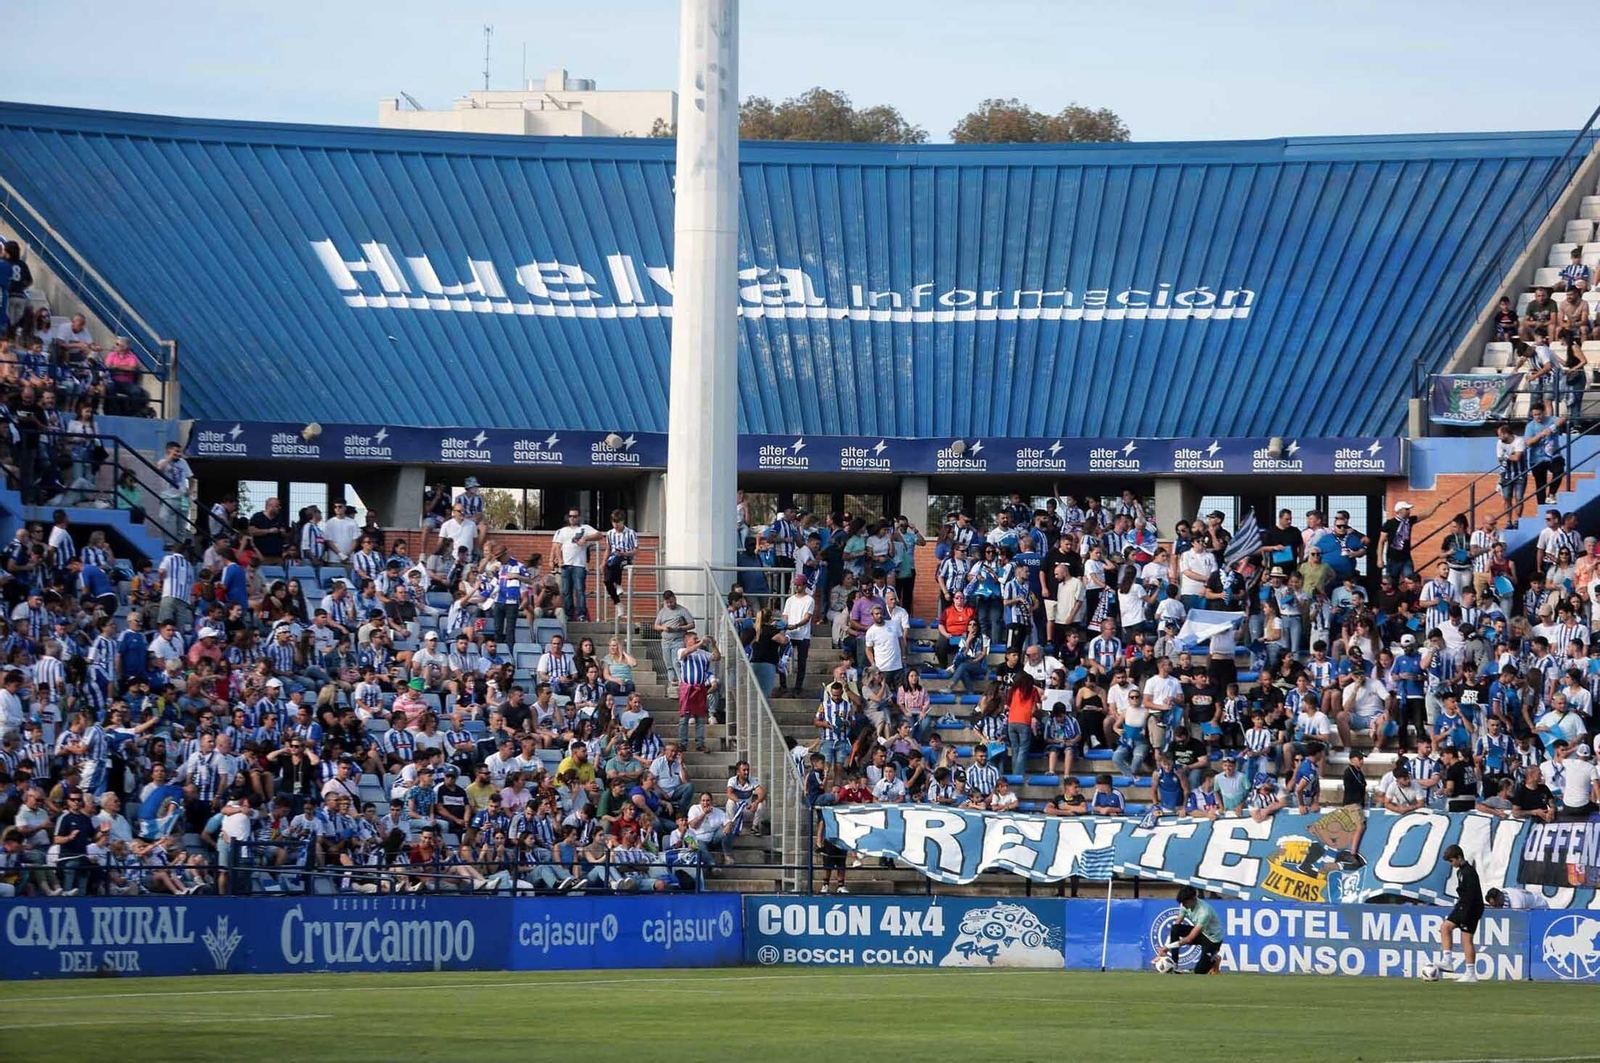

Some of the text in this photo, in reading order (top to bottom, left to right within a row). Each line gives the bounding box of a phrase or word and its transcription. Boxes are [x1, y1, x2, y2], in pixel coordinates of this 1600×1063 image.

[851, 278, 1256, 307] Información
[199, 431, 226, 442] alter
[272, 433, 299, 444] alter
[345, 435, 371, 446] alter
[198, 442, 247, 452] enersun
[271, 444, 320, 454] enersun
[442, 438, 469, 449] alter
[514, 440, 541, 450] alter
[344, 446, 392, 456] enersun
[441, 448, 491, 459] enersun
[513, 450, 563, 461] enersun
[759, 445, 787, 456] alter
[841, 447, 869, 458] alter
[1017, 448, 1045, 458] alter
[1090, 448, 1118, 459] alter
[1174, 449, 1202, 459] alter
[1335, 449, 1363, 460] alter
[591, 452, 640, 462] enersun
[759, 455, 809, 466] enersun
[841, 457, 891, 468] enersun
[937, 458, 987, 468] enersun
[1017, 458, 1066, 468] enersun
[1090, 459, 1140, 469] enersun
[1174, 459, 1224, 469] enersun
[1253, 459, 1303, 469] enersun
[1334, 459, 1385, 469] enersun
[833, 808, 1277, 888] FRENTE
[1264, 870, 1320, 902] ULTRAS
[879, 904, 945, 937] 4x4
[6, 906, 195, 950] CAJA RURAL
[642, 911, 716, 949] cajasur
[1226, 908, 1510, 946] HOTEL MARN
[281, 903, 475, 971] Cruzcampo
[518, 914, 599, 953] cajasur
[783, 945, 933, 965] BOSCH COLÓN
[1217, 943, 1366, 975] ALONSO
[60, 951, 140, 972] DEL SUR
